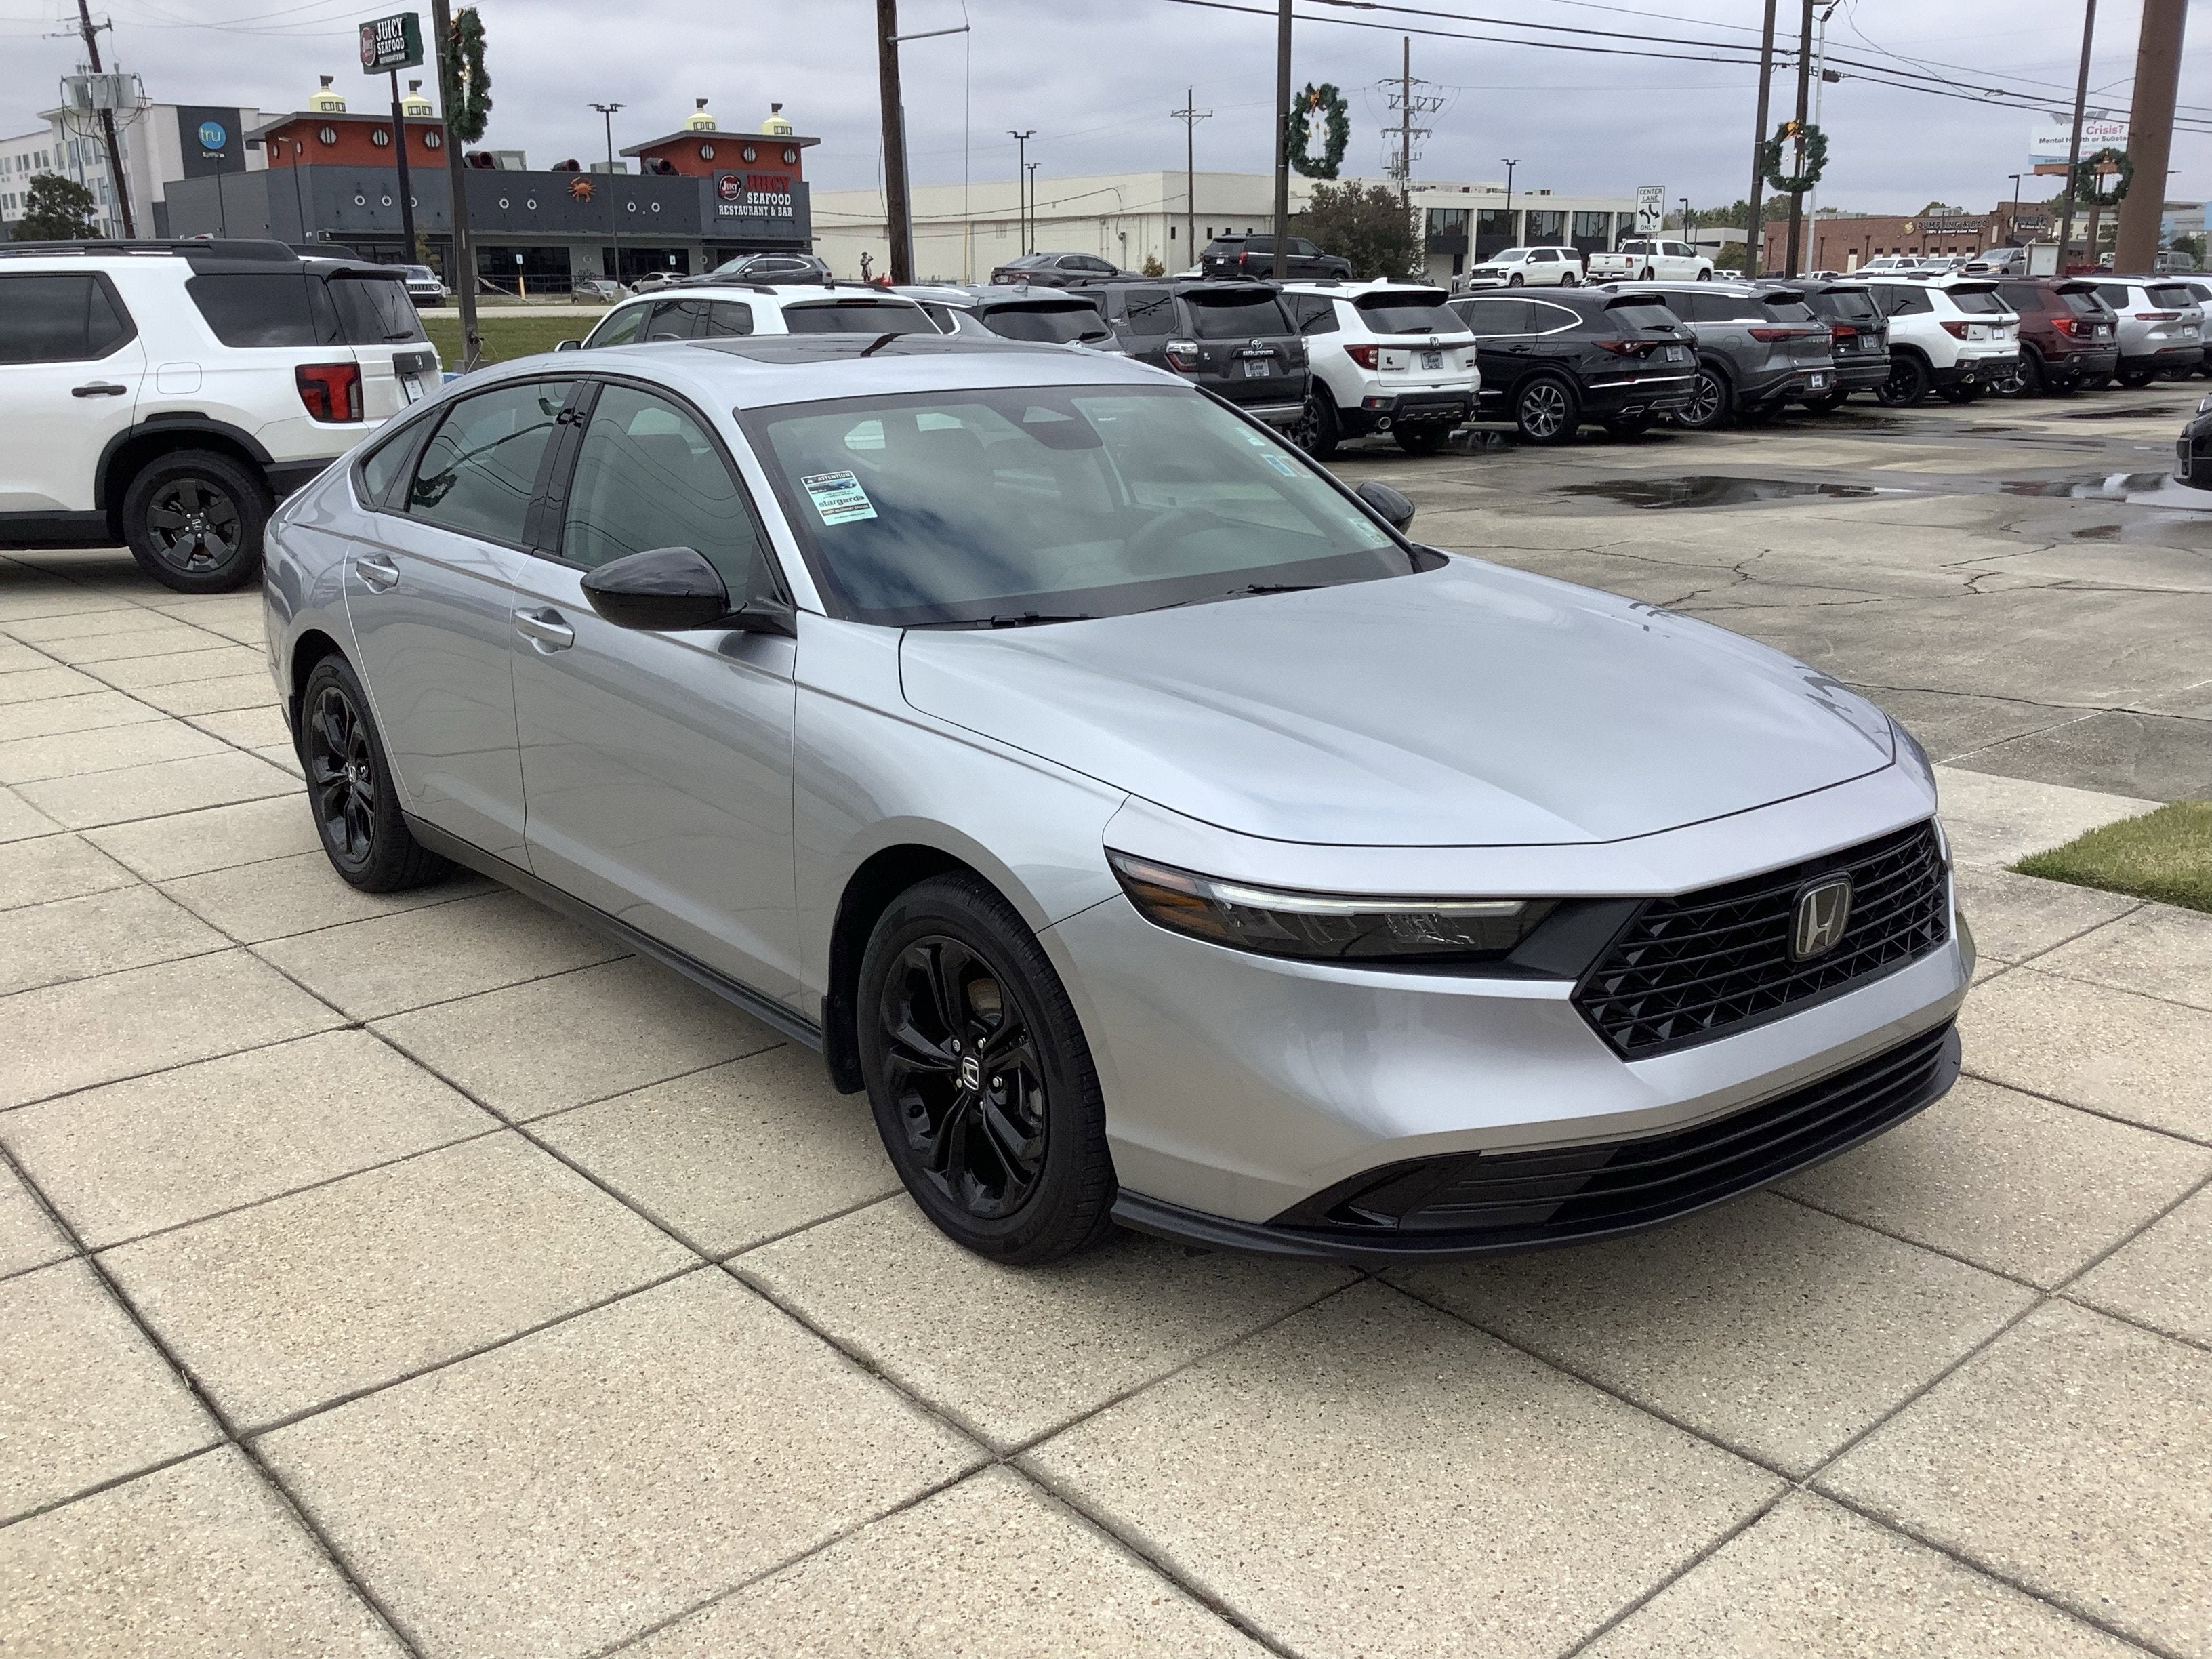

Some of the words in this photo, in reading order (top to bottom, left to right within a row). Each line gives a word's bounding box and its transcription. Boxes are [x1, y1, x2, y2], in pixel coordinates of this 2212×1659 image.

[376, 17, 403, 41] JUICY
[377, 37, 405, 54] SEAFOOD
[199, 127, 221, 142] tru
[2086, 125, 2124, 135] Crisis?
[745, 174, 790, 192] JUICY
[747, 192, 792, 205] SEAFOOD
[719, 205, 769, 216] RESTAURANT
[771, 206, 776, 216] &
[778, 207, 793, 217] BAR
[1917, 220, 1961, 229] DUMPING
[1963, 220, 1969, 228] &
[1970, 220, 1988, 228] BAO
[817, 472, 851, 482] ATTENTION
